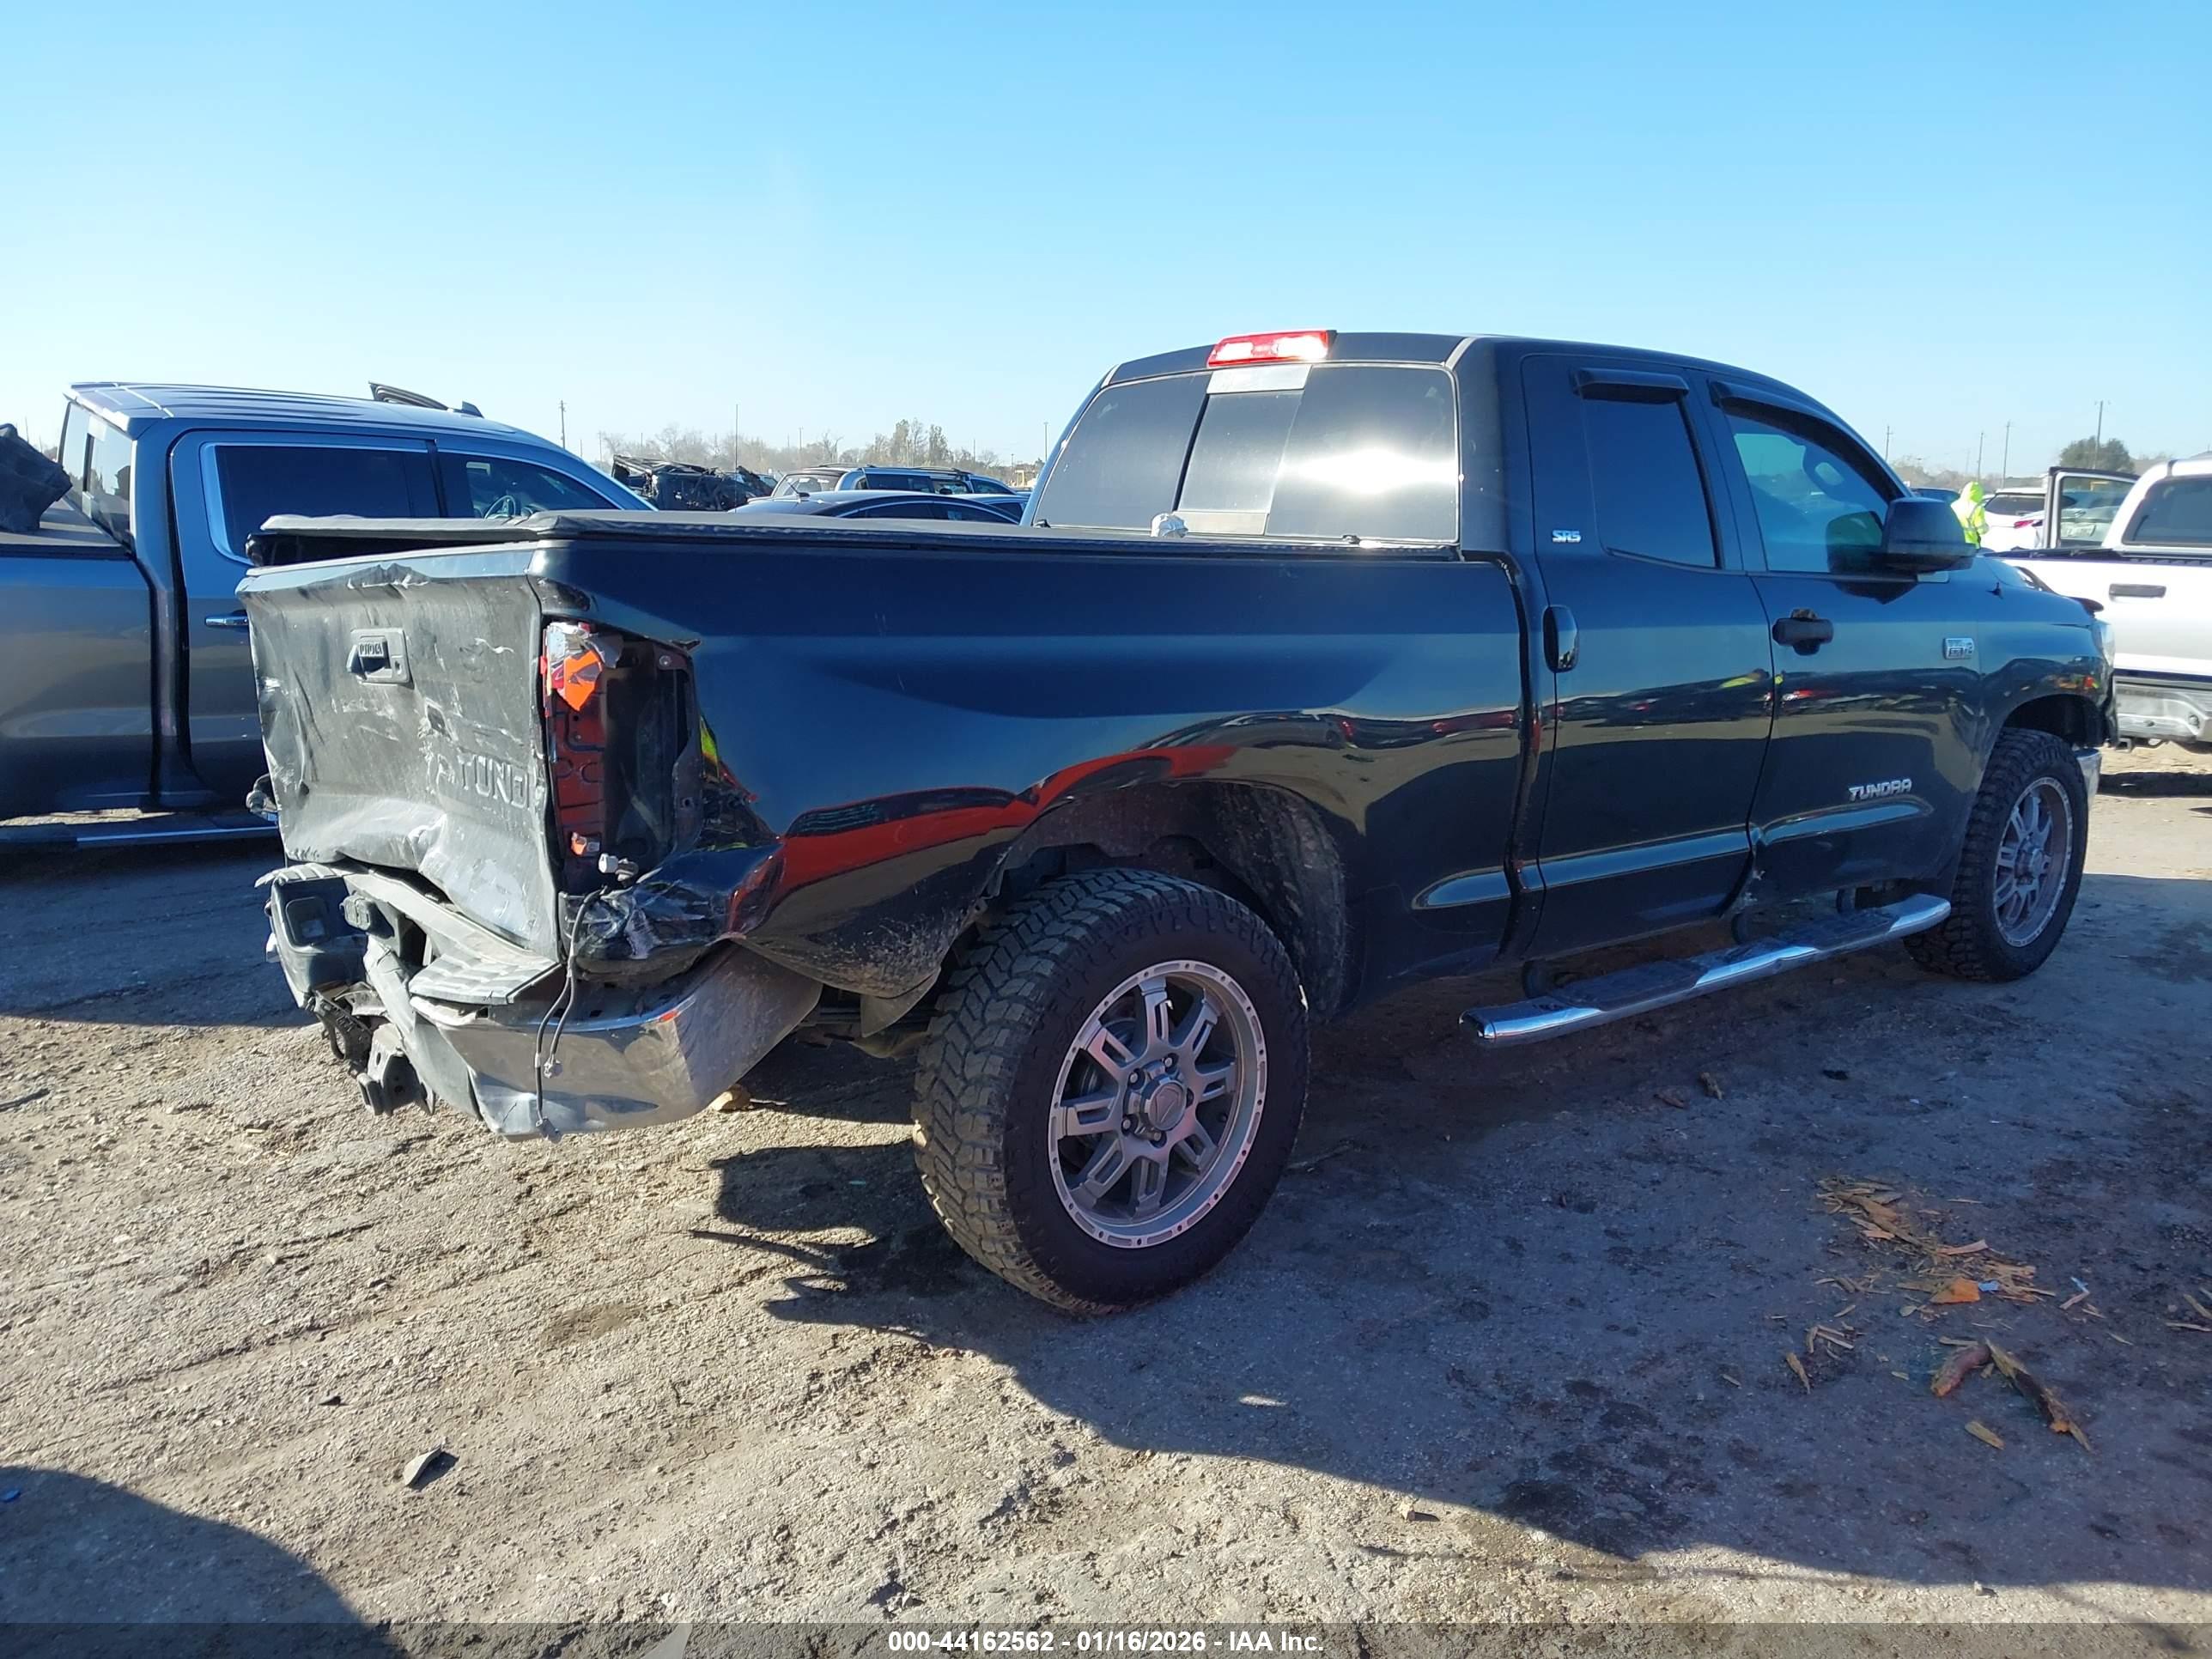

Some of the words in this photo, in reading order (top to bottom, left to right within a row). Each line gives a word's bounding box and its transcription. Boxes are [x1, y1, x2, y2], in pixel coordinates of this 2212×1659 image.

[1552, 529, 1582, 543] SR5
[456, 753, 530, 809] TUND
[1848, 778, 1912, 802] TUNDRA
